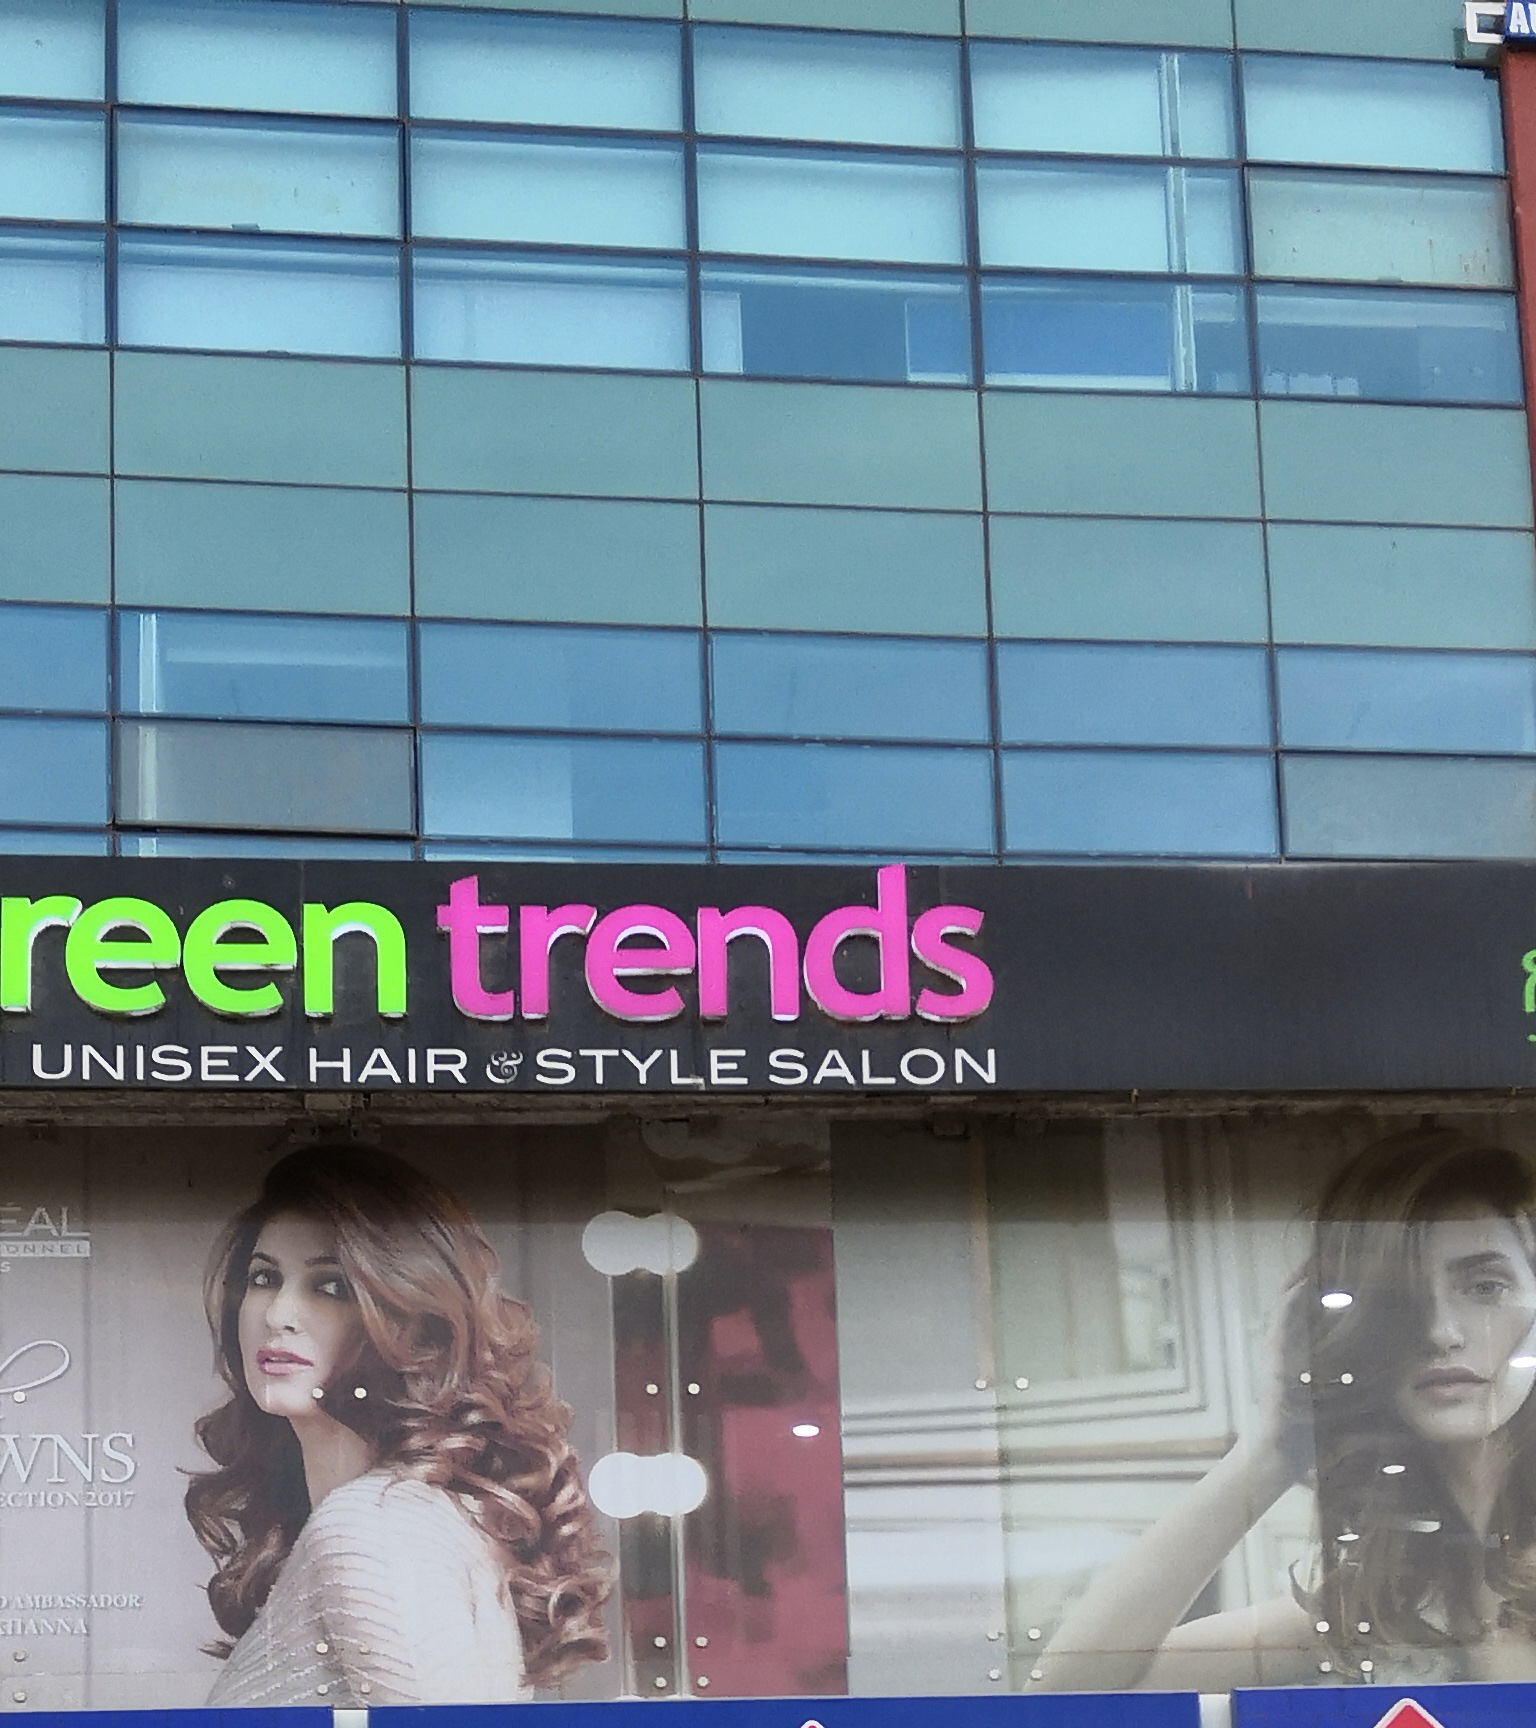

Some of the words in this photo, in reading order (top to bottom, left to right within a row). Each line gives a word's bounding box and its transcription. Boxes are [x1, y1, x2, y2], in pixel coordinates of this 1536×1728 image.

[435, 862, 996, 1024] trends
[30, 1043, 285, 1086] UNISEX
[307, 1045, 467, 1085] HAIR
[534, 1047, 749, 1086] STYLE
[766, 1047, 996, 1086] SALON
[83, 1489, 136, 1508] 2017
[13, 1593, 144, 1611] AMBASSADOR
